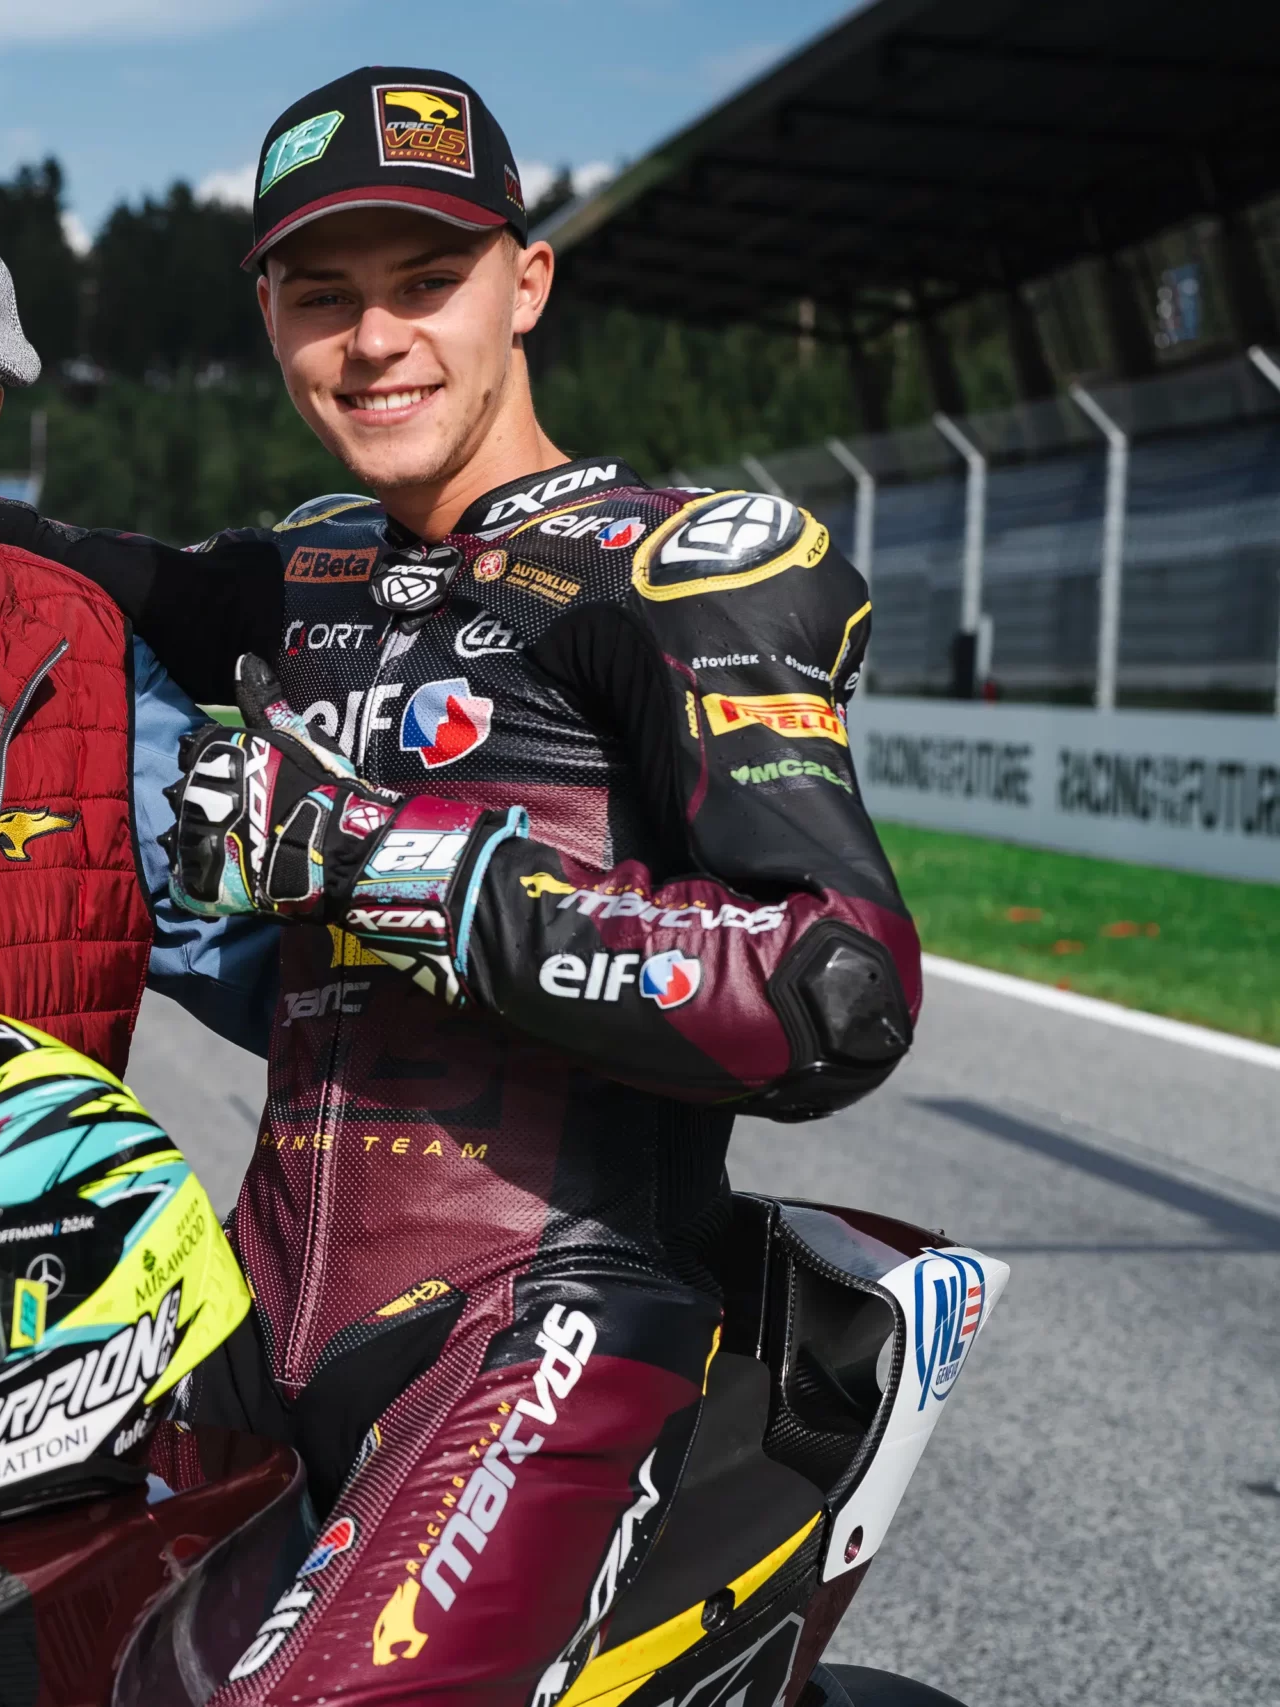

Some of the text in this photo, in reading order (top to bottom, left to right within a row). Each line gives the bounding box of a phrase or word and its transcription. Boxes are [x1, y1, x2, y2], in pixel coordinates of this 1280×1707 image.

[440, 155, 465, 165] TEAM
[540, 515, 613, 538] elf
[312, 552, 368, 577] Beta
[511, 563, 581, 596] AUTOKLUB
[539, 954, 639, 1001] elf
[363, 1136, 488, 1160] TEAM
[135, 1215, 205, 1307] MIRAWOOD
[935, 1361, 960, 1386] GENEVA
[405, 1475, 465, 1575] RACING
